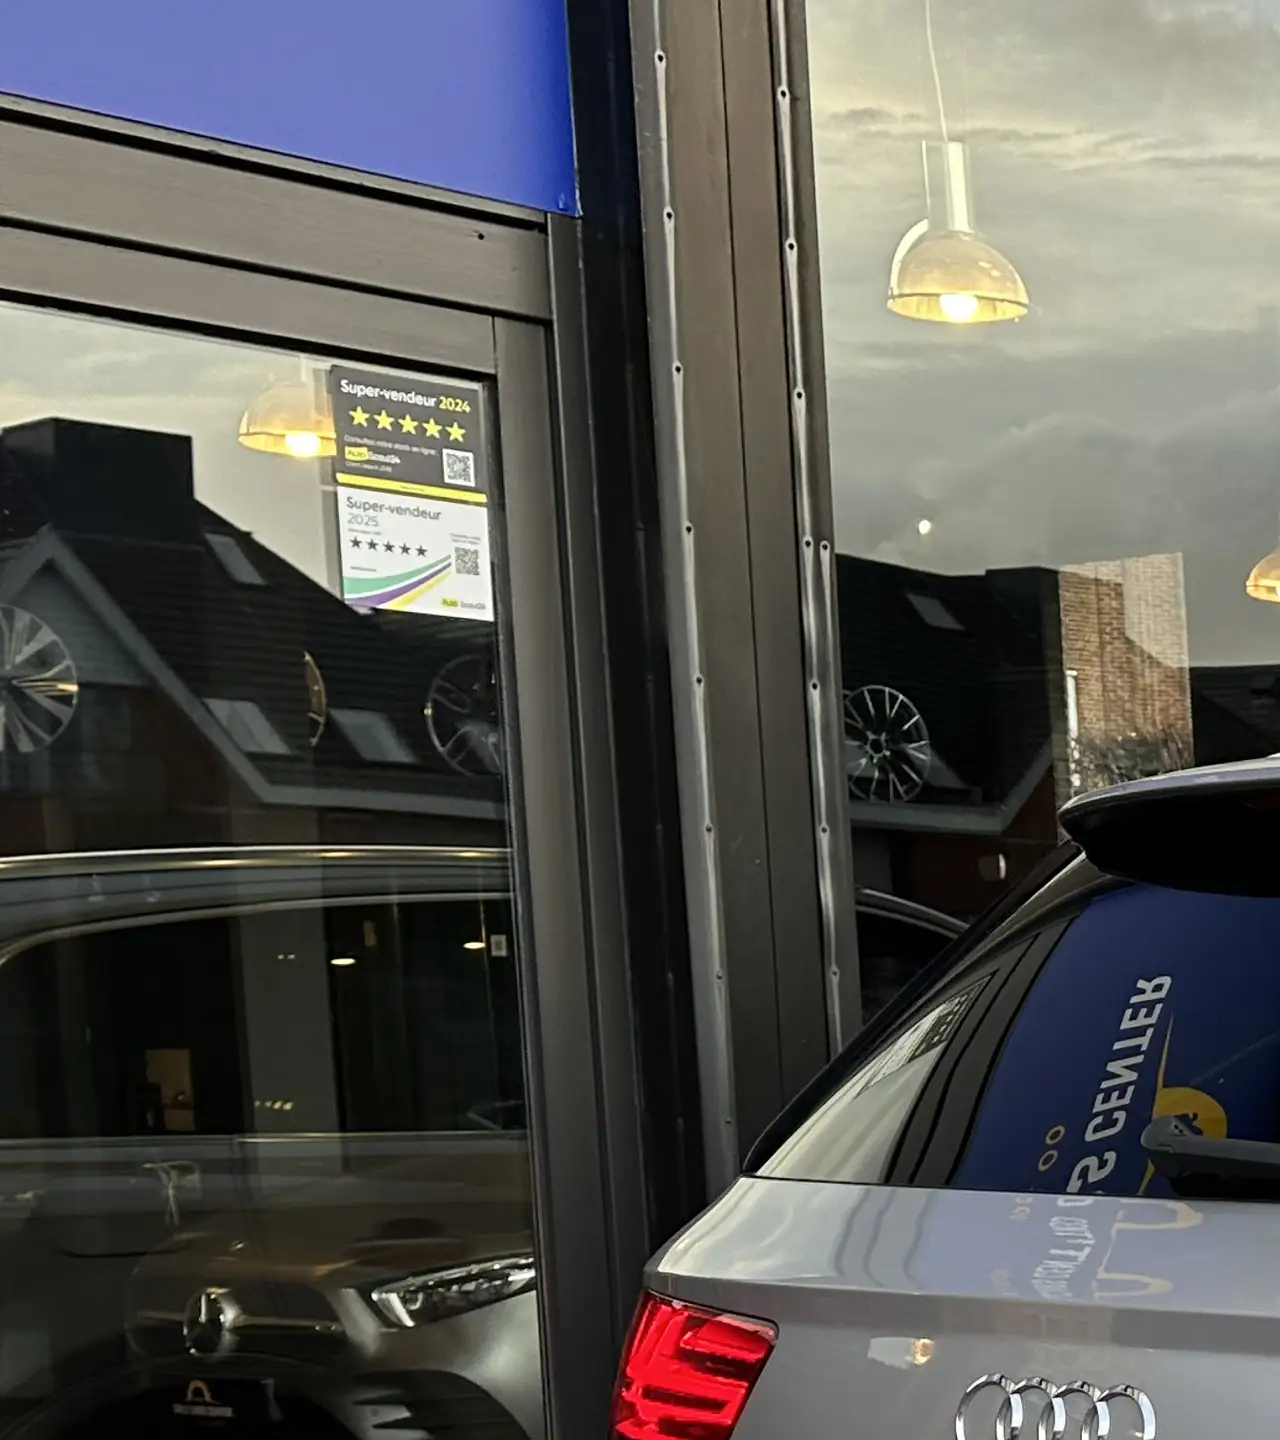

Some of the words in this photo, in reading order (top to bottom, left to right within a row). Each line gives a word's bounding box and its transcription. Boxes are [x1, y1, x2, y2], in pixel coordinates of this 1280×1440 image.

[340, 379, 437, 407] Super-vendeur
[438, 396, 472, 413] 2024
[346, 496, 442, 521] Super-vendeur
[347, 512, 380, 528] 2025
